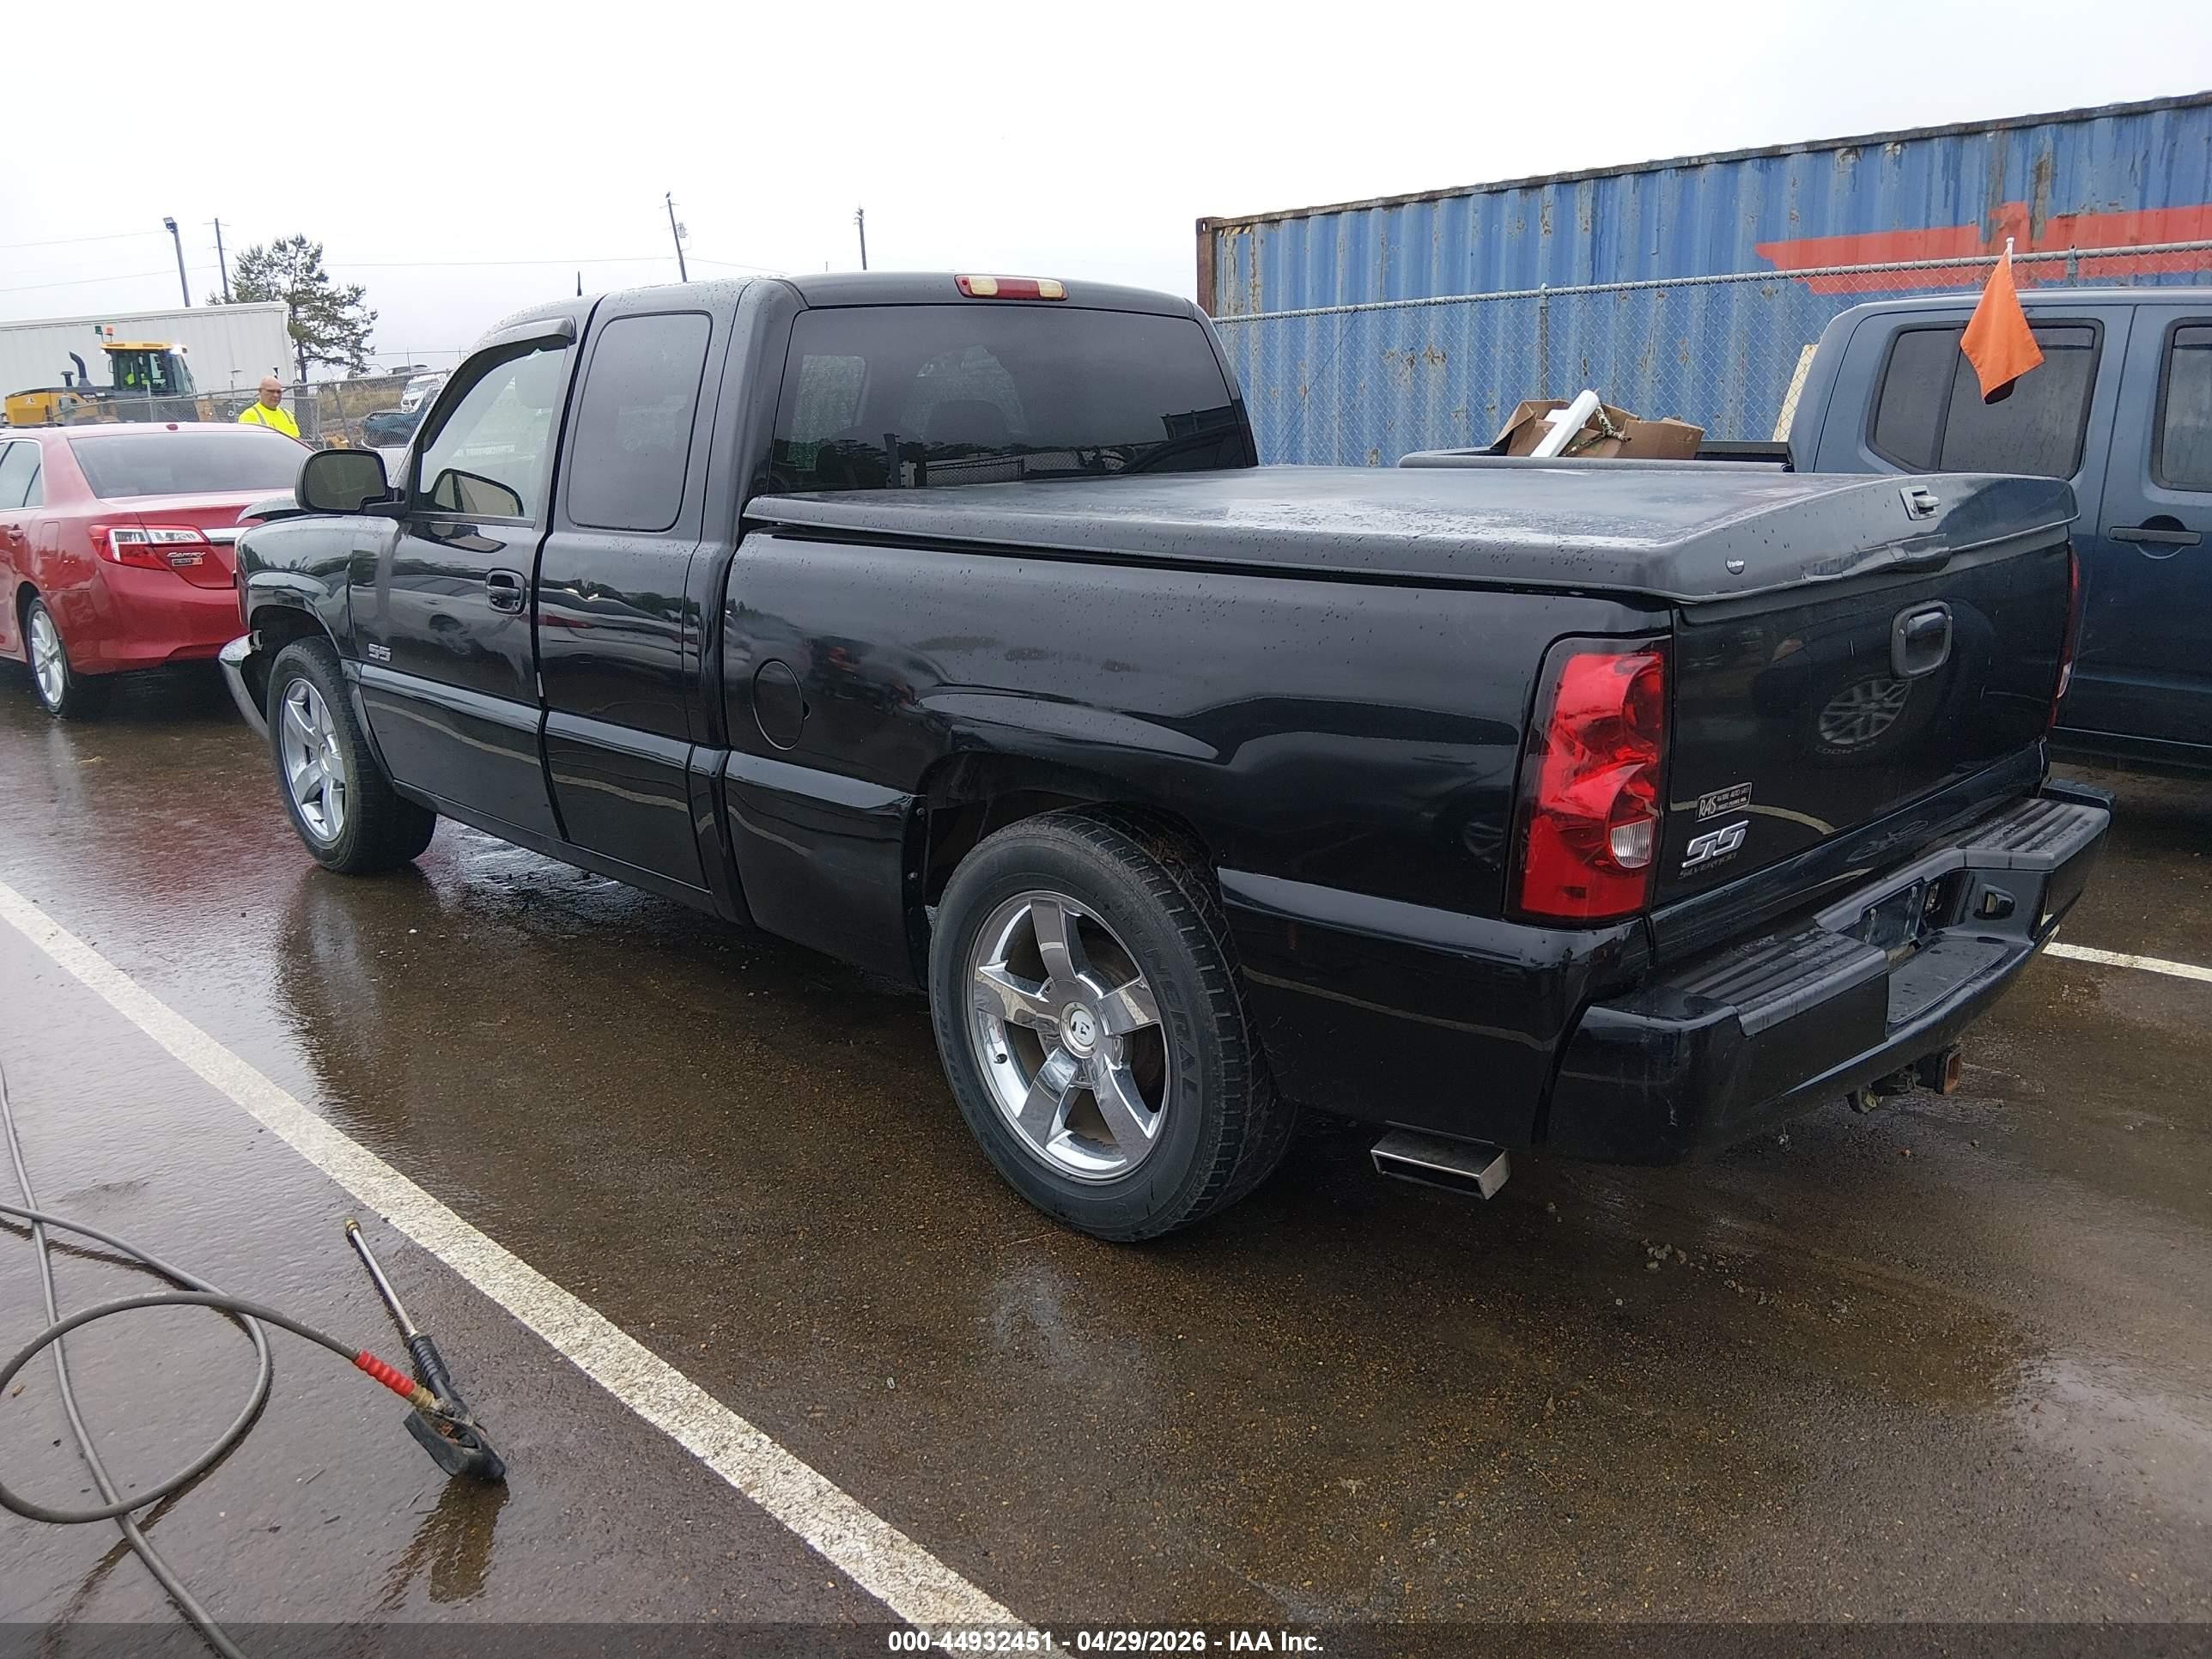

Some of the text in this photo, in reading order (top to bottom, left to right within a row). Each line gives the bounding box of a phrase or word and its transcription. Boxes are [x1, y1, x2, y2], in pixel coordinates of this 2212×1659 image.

[368, 642, 392, 662] SS
[1698, 795, 1717, 818] RAS
[1681, 819, 1750, 868] SS
